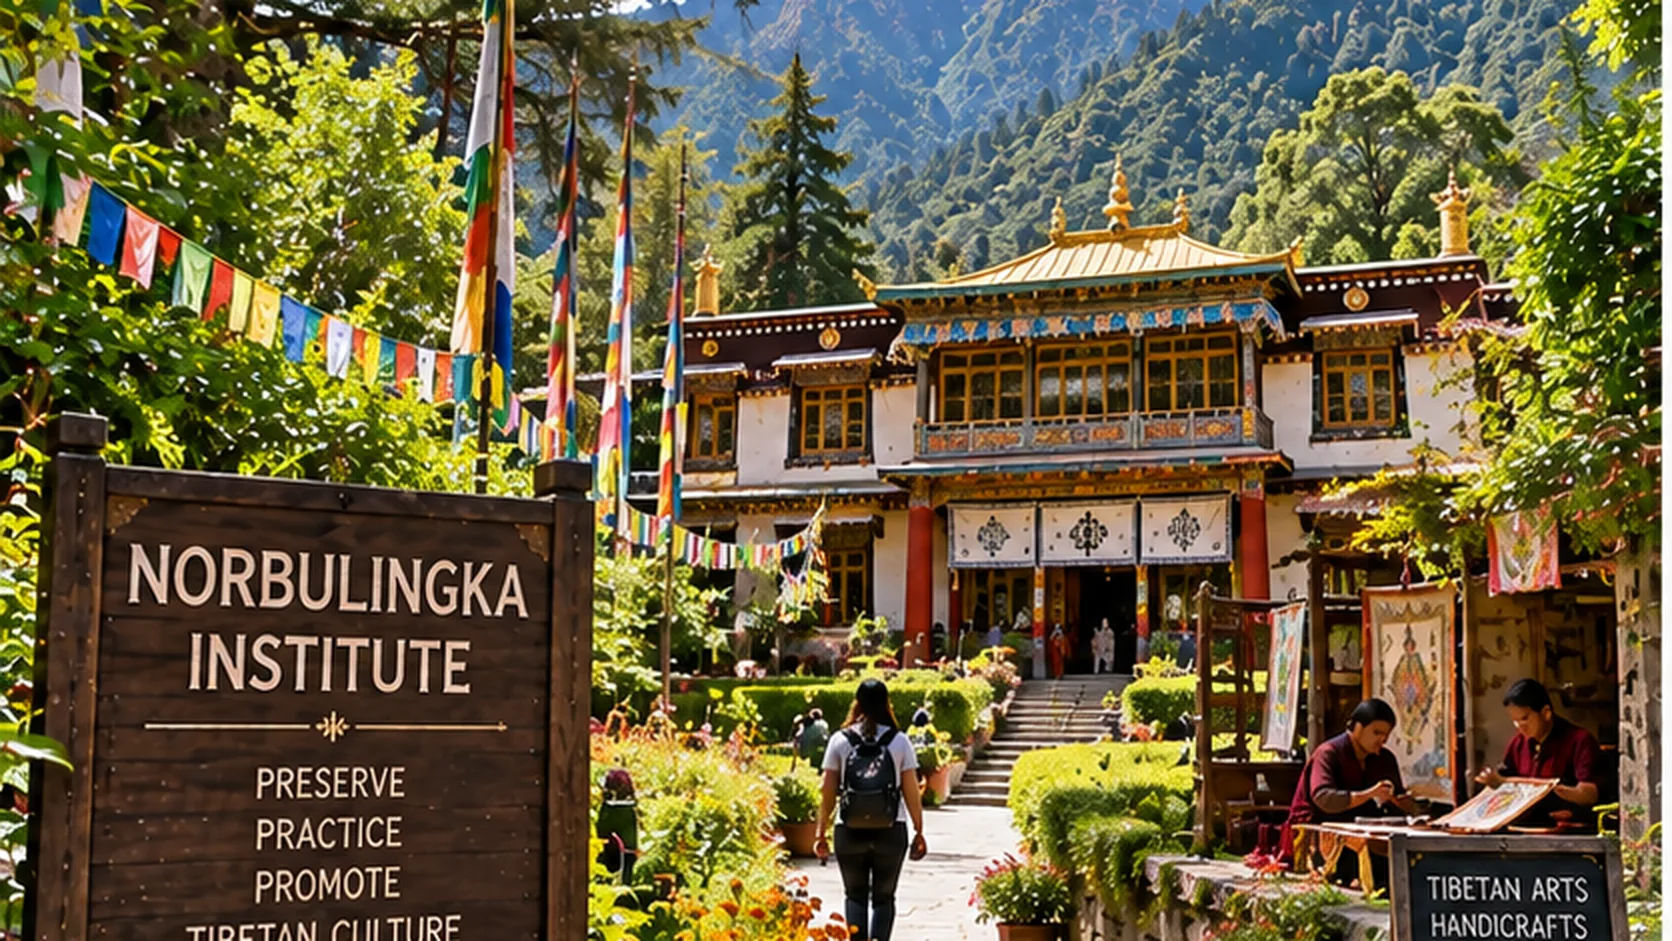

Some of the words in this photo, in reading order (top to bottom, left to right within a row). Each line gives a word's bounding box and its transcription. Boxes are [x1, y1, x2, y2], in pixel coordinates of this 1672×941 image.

[128, 543, 529, 618] NORBULINGKA
[189, 633, 471, 694] INSTITUTE
[256, 766, 405, 799] PRESERVE
[256, 816, 402, 850] PRACTICE
[255, 866, 401, 903] PROMOTE
[1426, 875, 1521, 902] TIBETAN
[1531, 876, 1589, 902] ARTS
[331, 914, 462, 941] CULTURE
[1431, 913, 1588, 940] HANDICRAFTS
